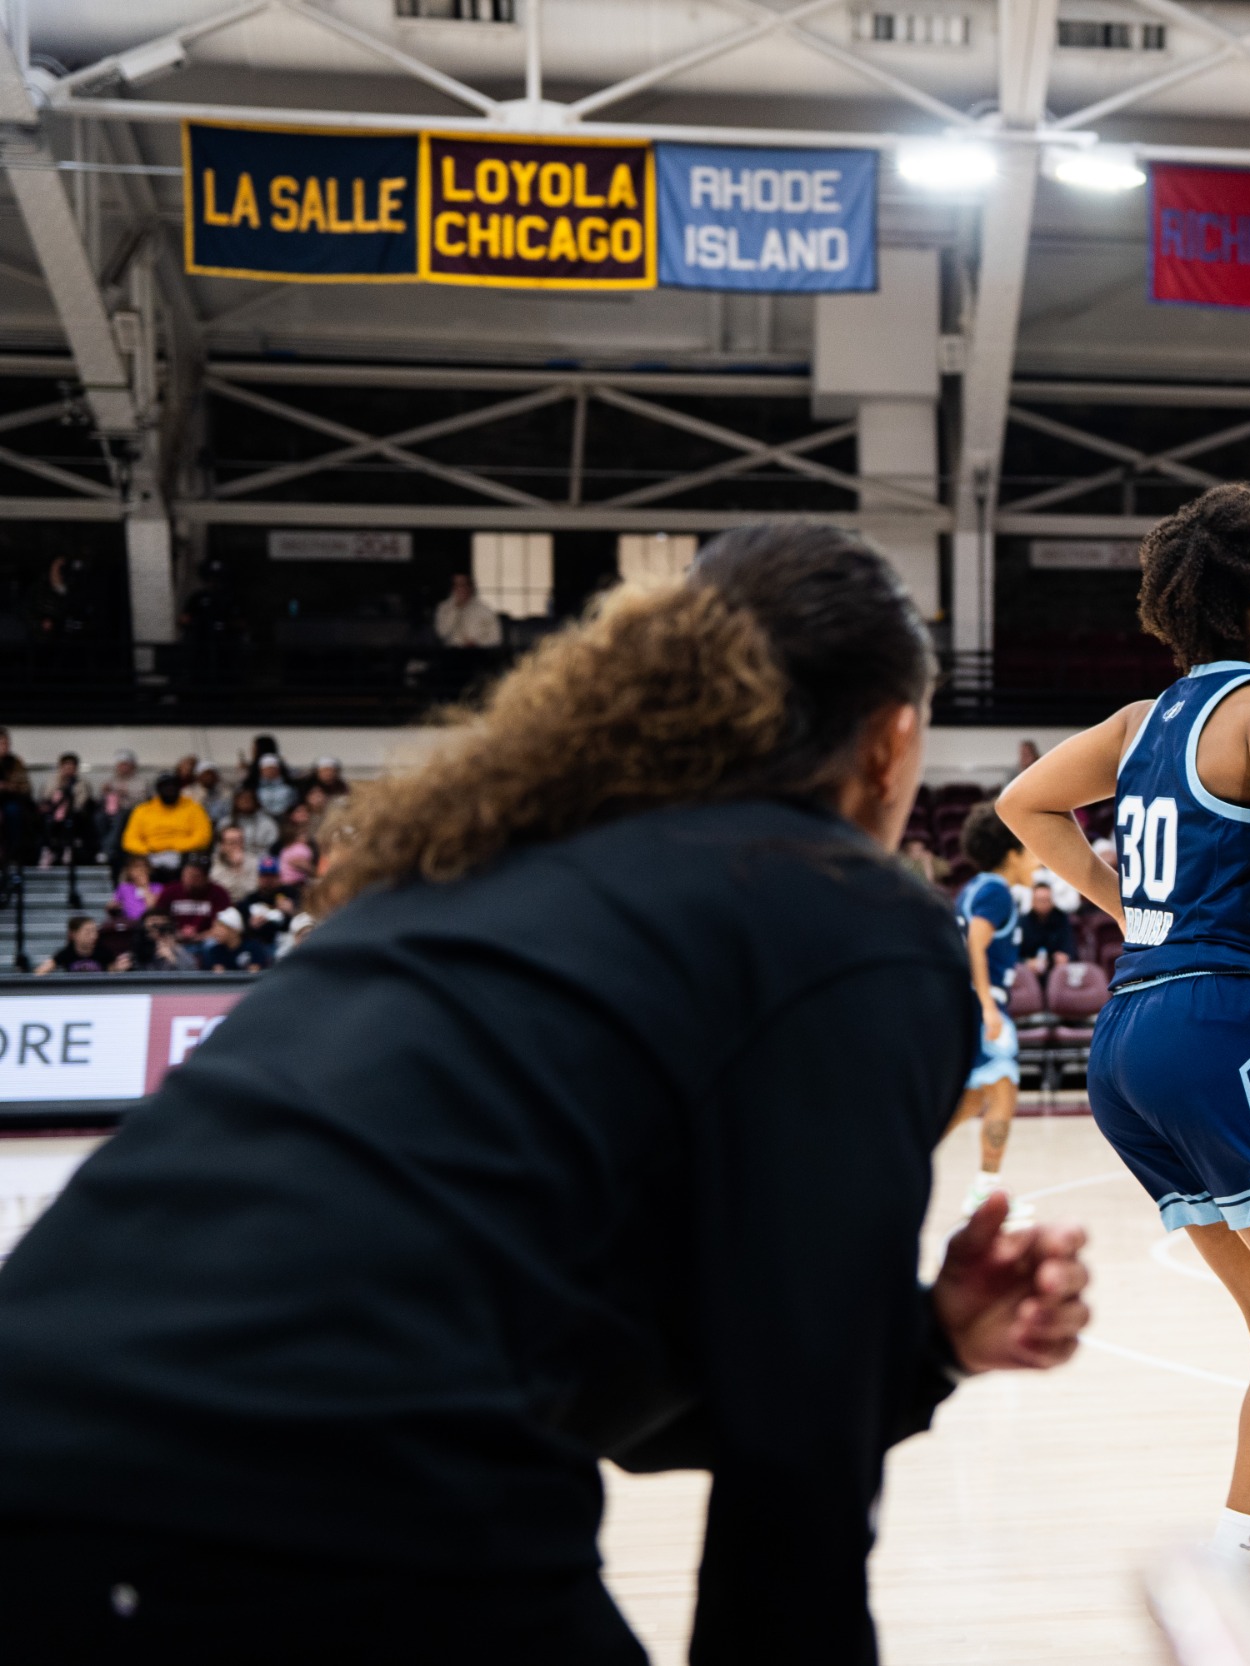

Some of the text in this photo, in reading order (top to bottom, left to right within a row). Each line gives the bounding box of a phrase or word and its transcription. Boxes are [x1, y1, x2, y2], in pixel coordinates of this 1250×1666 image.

[204, 170, 407, 234] LA SALLE
[442, 156, 638, 208] LOYOLA
[691, 166, 841, 213] RHODE
[434, 211, 643, 263] CHICAGO
[685, 225, 849, 271] ISLAND
[1117, 795, 1178, 902] 30
[0, 1020, 94, 1066] RE
[167, 1015, 227, 1067] F
